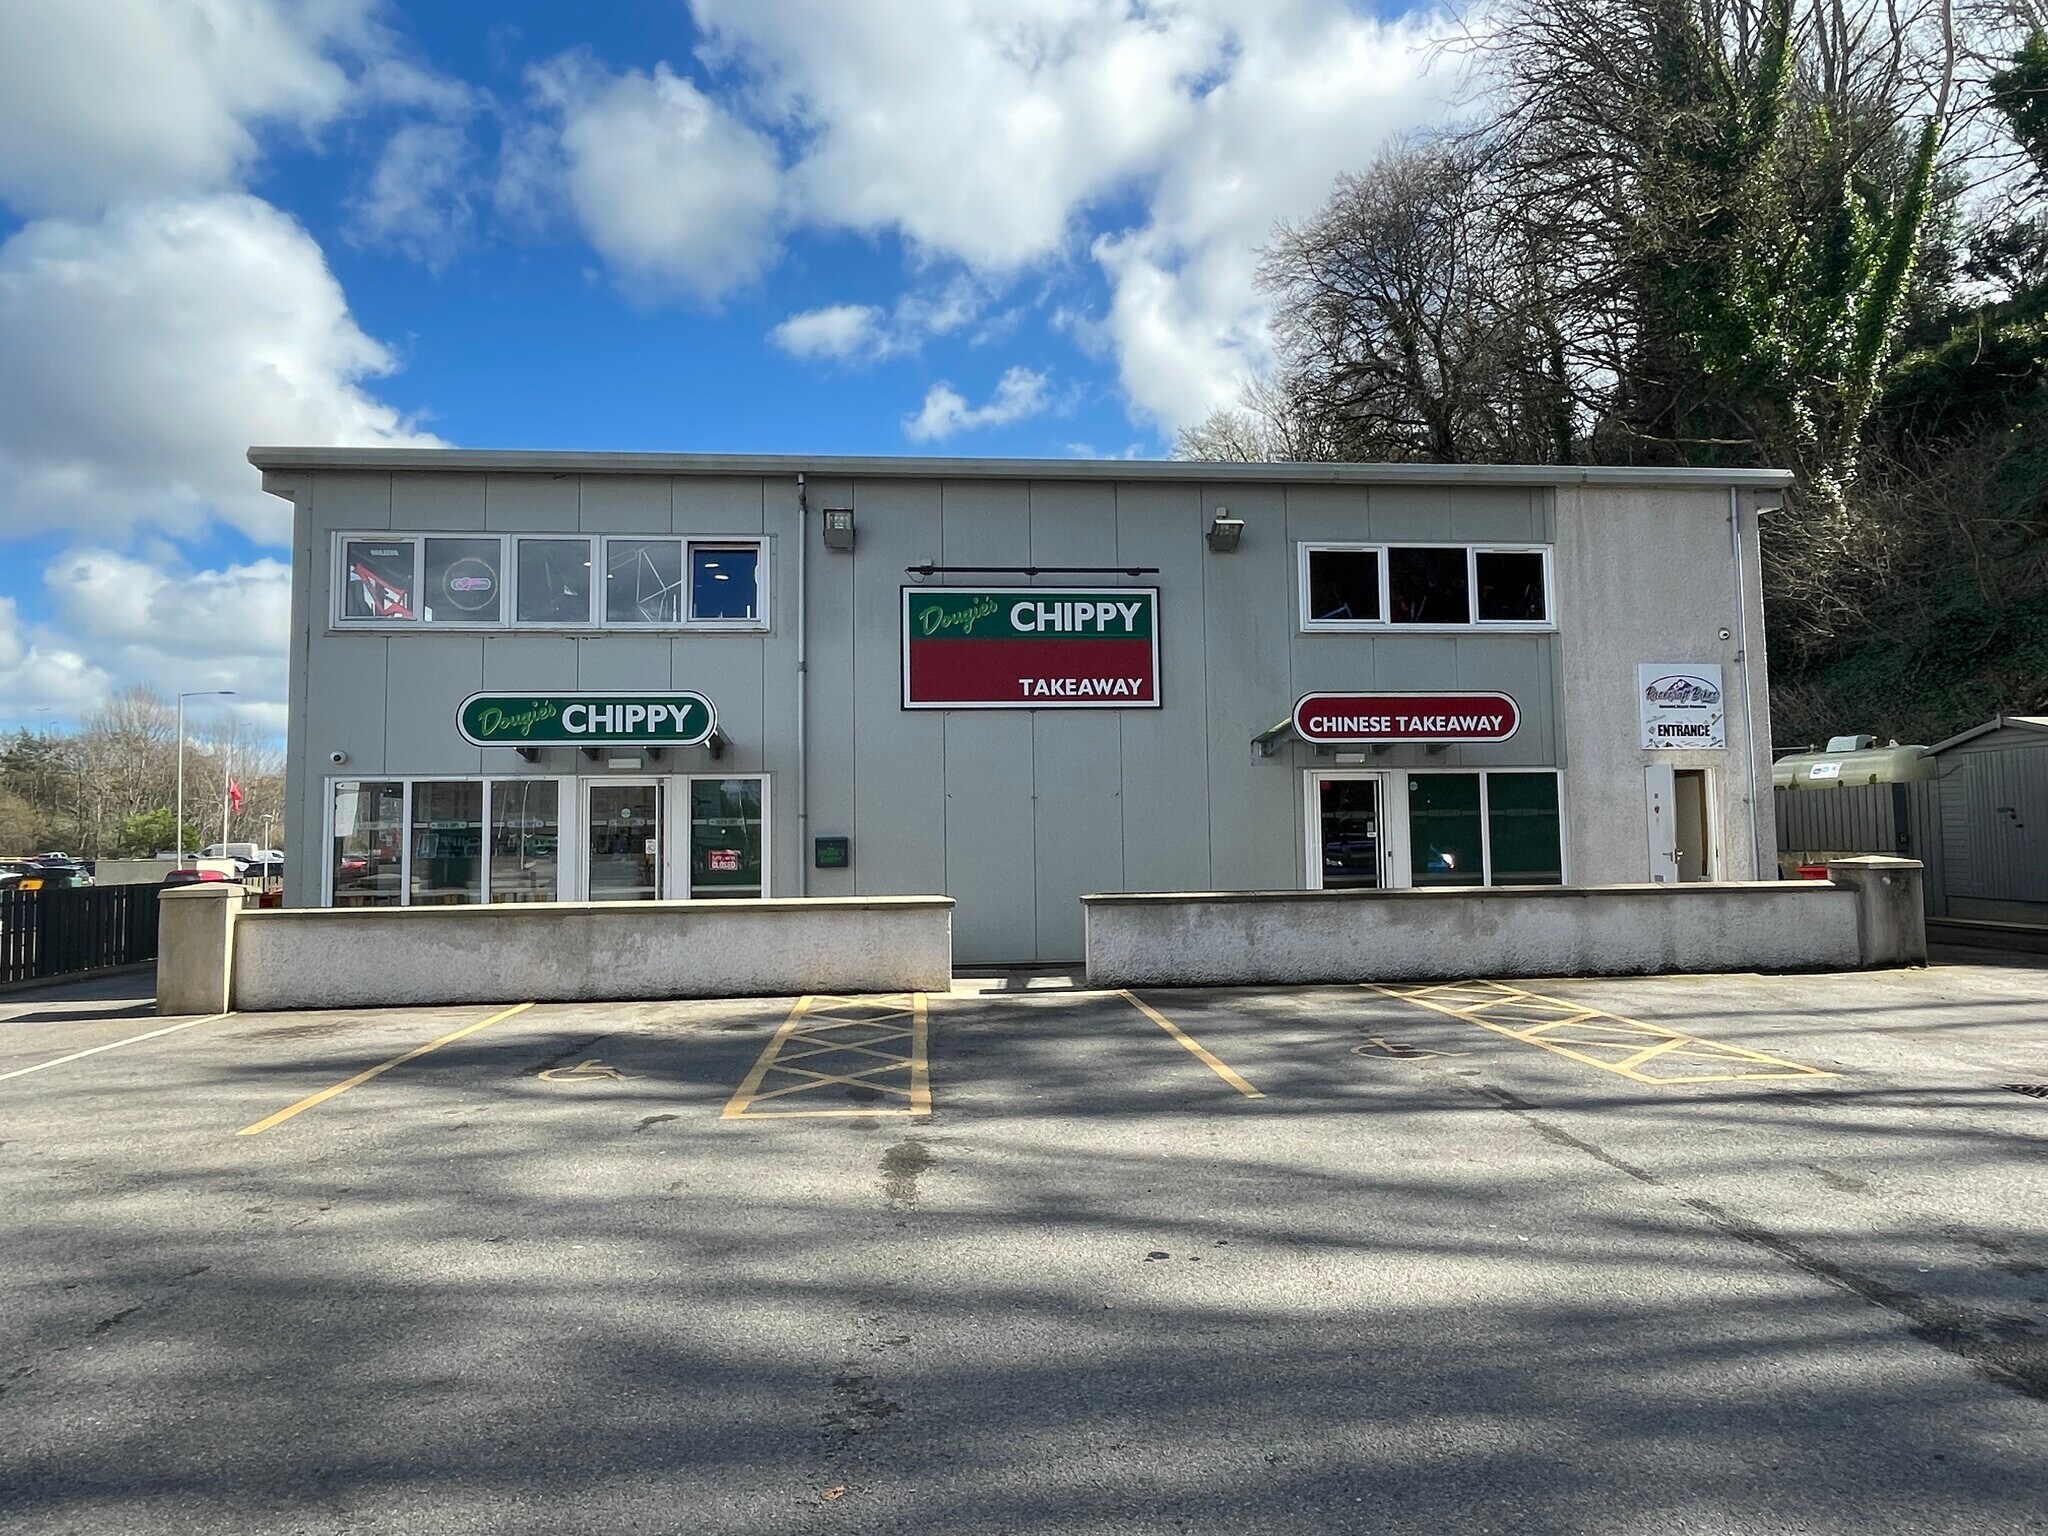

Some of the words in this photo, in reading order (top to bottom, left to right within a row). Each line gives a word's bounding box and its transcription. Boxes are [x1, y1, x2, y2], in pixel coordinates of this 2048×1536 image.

[919, 597, 998, 635] Dougie's
[1011, 602, 1142, 632] CHIPPY
[1019, 678, 1143, 696] TAKEAWAY
[478, 700, 556, 736] Dougie's
[563, 705, 692, 733] CHIPPY
[1309, 716, 1391, 733] CHINESE
[1396, 715, 1504, 732] TAKEAWAY
[1657, 724, 1711, 737] ENTRANCE
